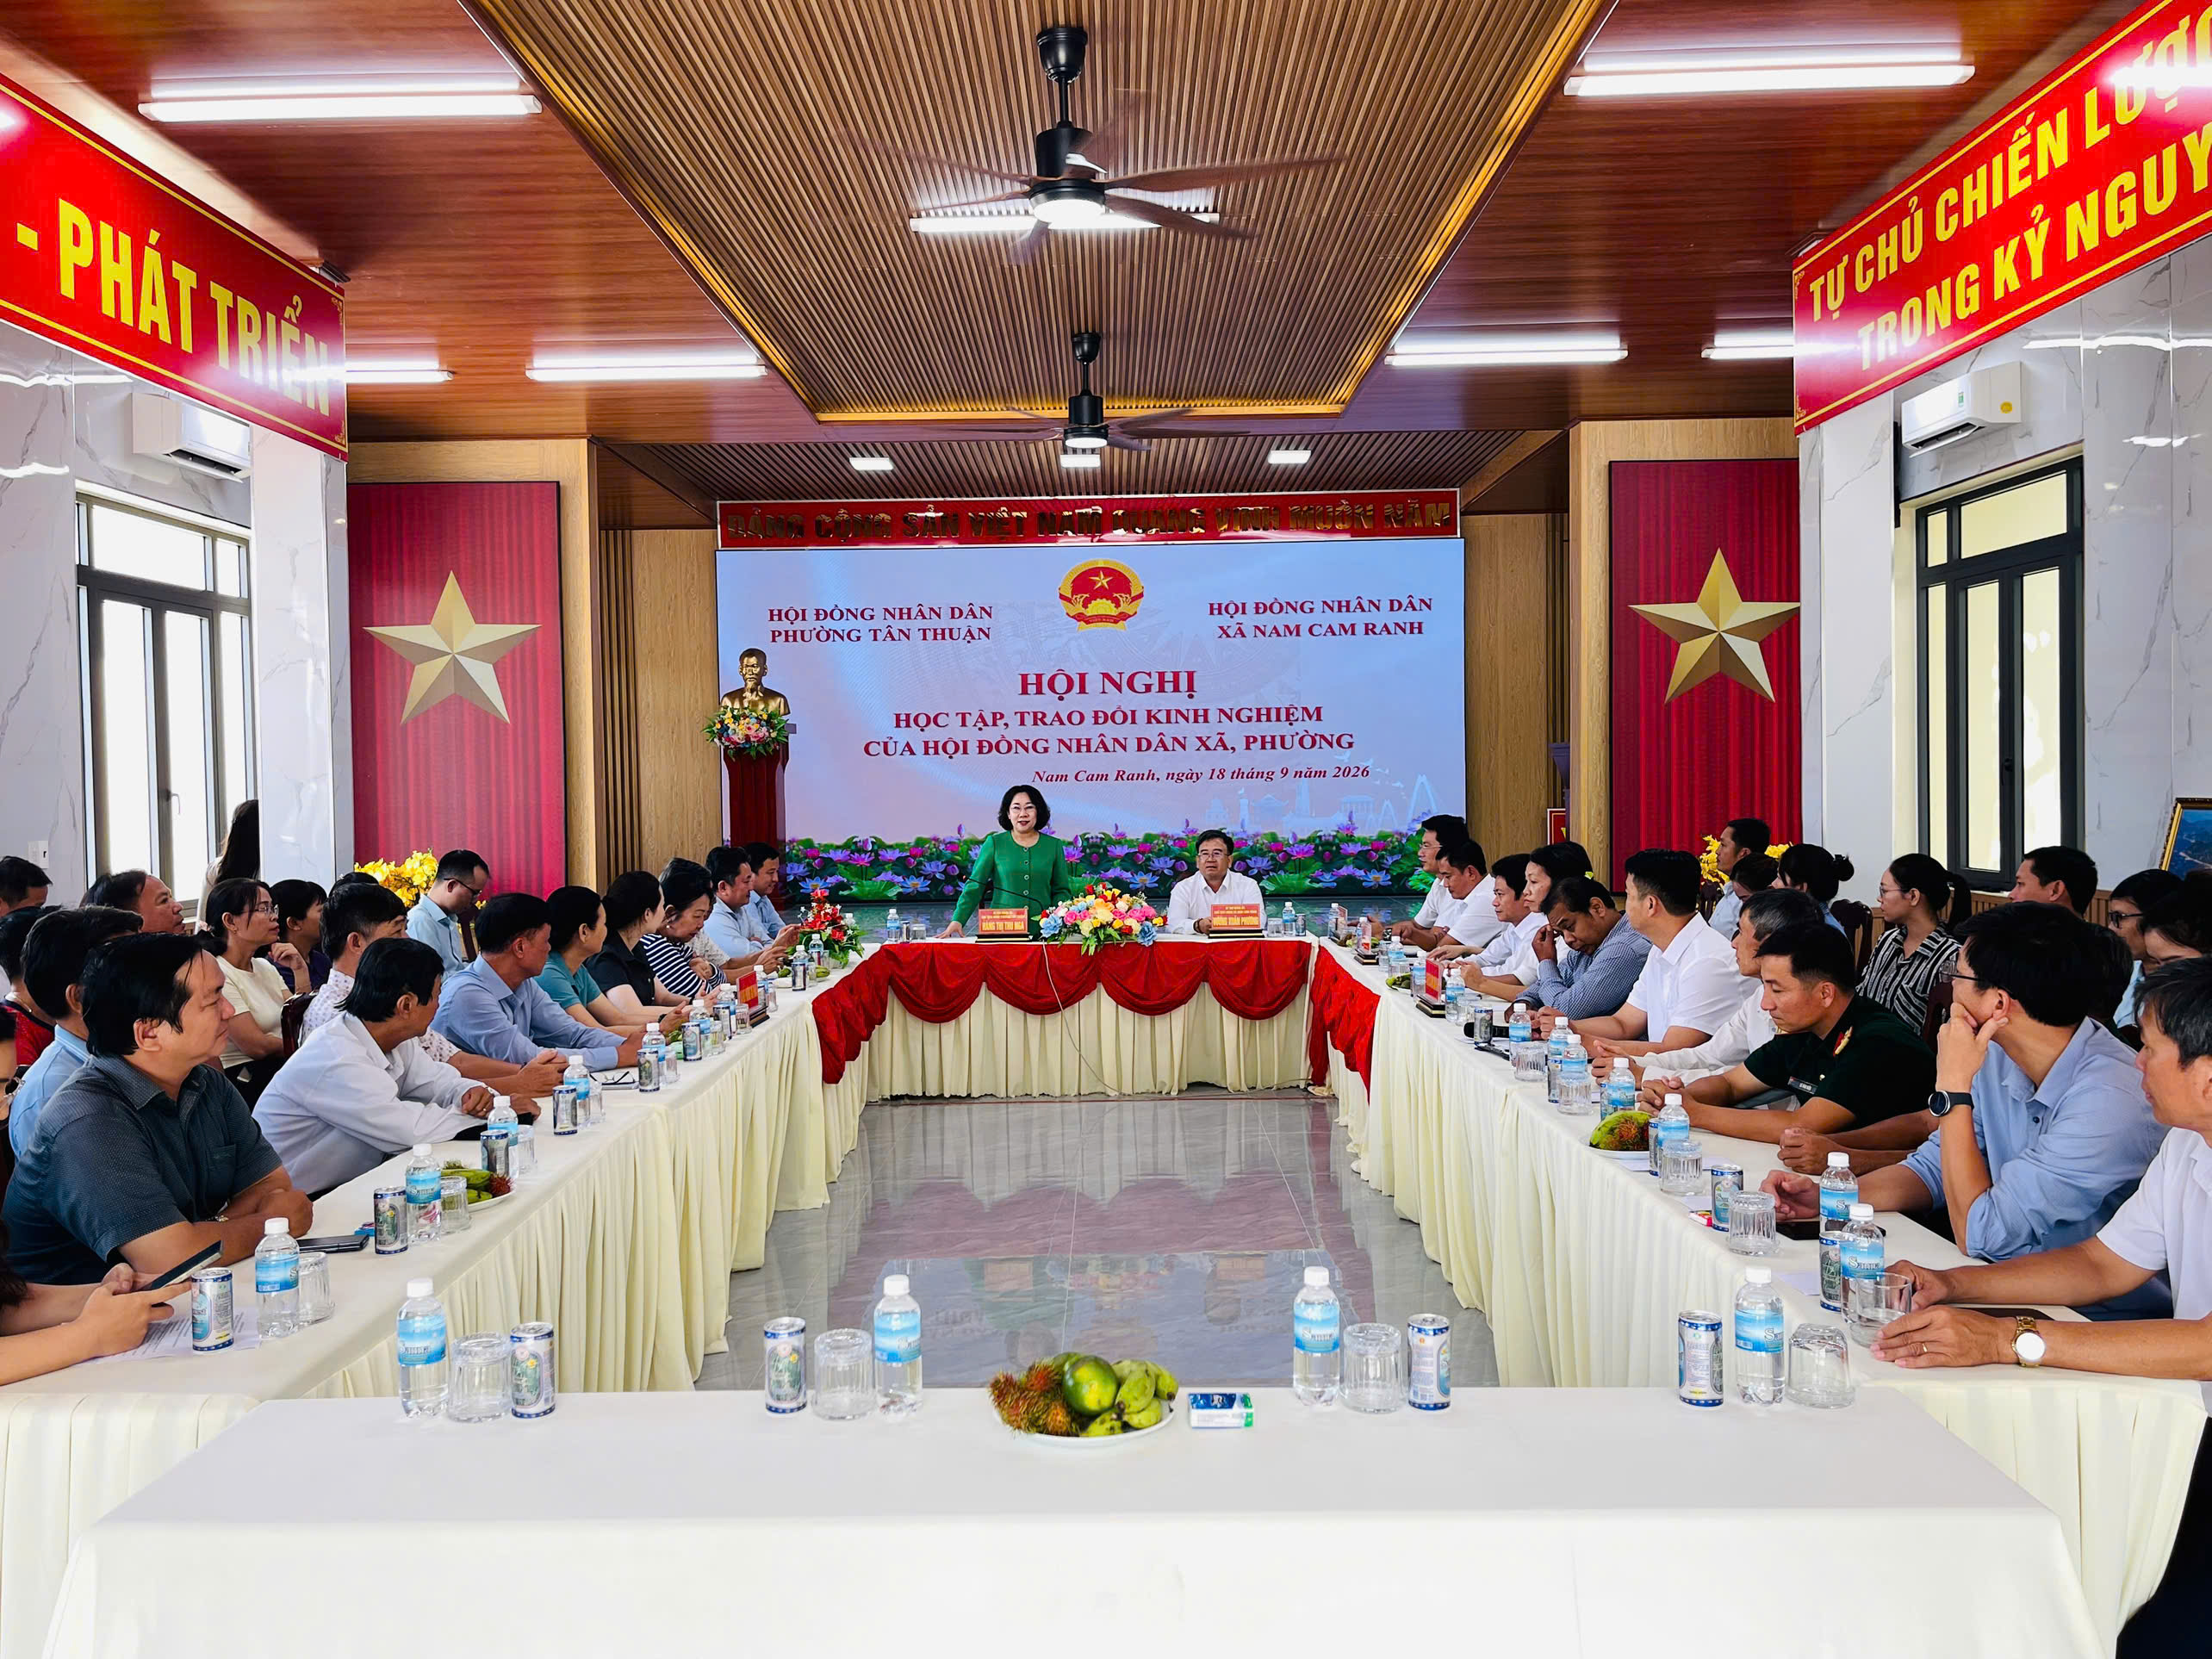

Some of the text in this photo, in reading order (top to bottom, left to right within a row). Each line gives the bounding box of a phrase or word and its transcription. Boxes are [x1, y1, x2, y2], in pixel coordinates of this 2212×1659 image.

[1809, 254, 1849, 320] TỰ
[1855, 195, 1923, 293] CHỦ
[1936, 107, 2068, 242] CHIẾN
[1857, 263, 1979, 370] TRONG
[1994, 204, 2051, 301] KỶ
[59, 197, 197, 354] PHÁT
[210, 281, 330, 416] TRIỂN
[902, 504, 960, 538] SẢN
[968, 506, 1028, 540] VIỆT
[1037, 510, 1103, 536] NAM
[1112, 508, 1206, 535] QUANG
[1215, 506, 1281, 531] VINH
[1289, 500, 1374, 531] MUÔN
[1383, 499, 1451, 528] NĂM
[768, 603, 992, 624] HỘI ĐỒNG NHÂN DÂN
[1209, 594, 1432, 618] HỘI ĐỒNG NHÂN DÂN
[770, 624, 991, 643] PHƯỜNG TÂN THUẬN
[1217, 622, 1424, 638] XÃ NAM CAM RANH
[1018, 668, 1197, 701] HỘI NGHỊ
[893, 705, 1323, 732] HỌC TẬP, TRAO ĐỔI KINH NGHIỆM
[864, 730, 1354, 759] CỦA HỘI ĐỒNG NHÂN DÂN XÃ, PHƯỜNG
[1032, 766, 1370, 783] Nam Cam Ranh, ngày 18 tháng 9 năm 2026
